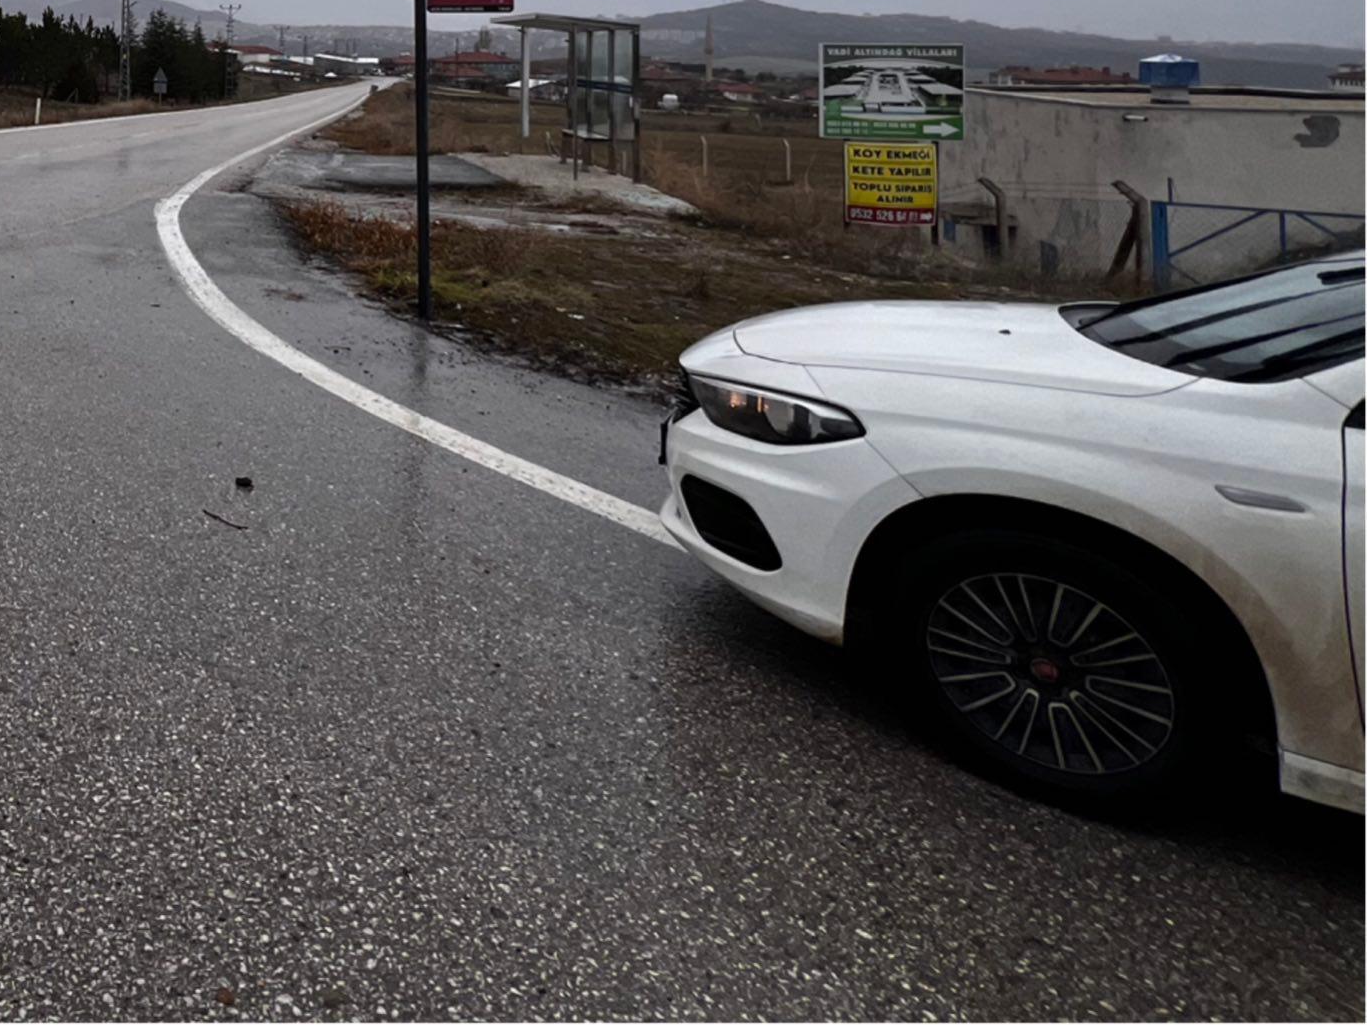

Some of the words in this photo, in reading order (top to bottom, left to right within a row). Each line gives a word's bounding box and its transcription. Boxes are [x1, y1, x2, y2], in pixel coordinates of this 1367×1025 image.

[852, 166, 884, 175] KETE
[888, 167, 931, 176] YAPILIR
[853, 182, 891, 192] TOPLU
